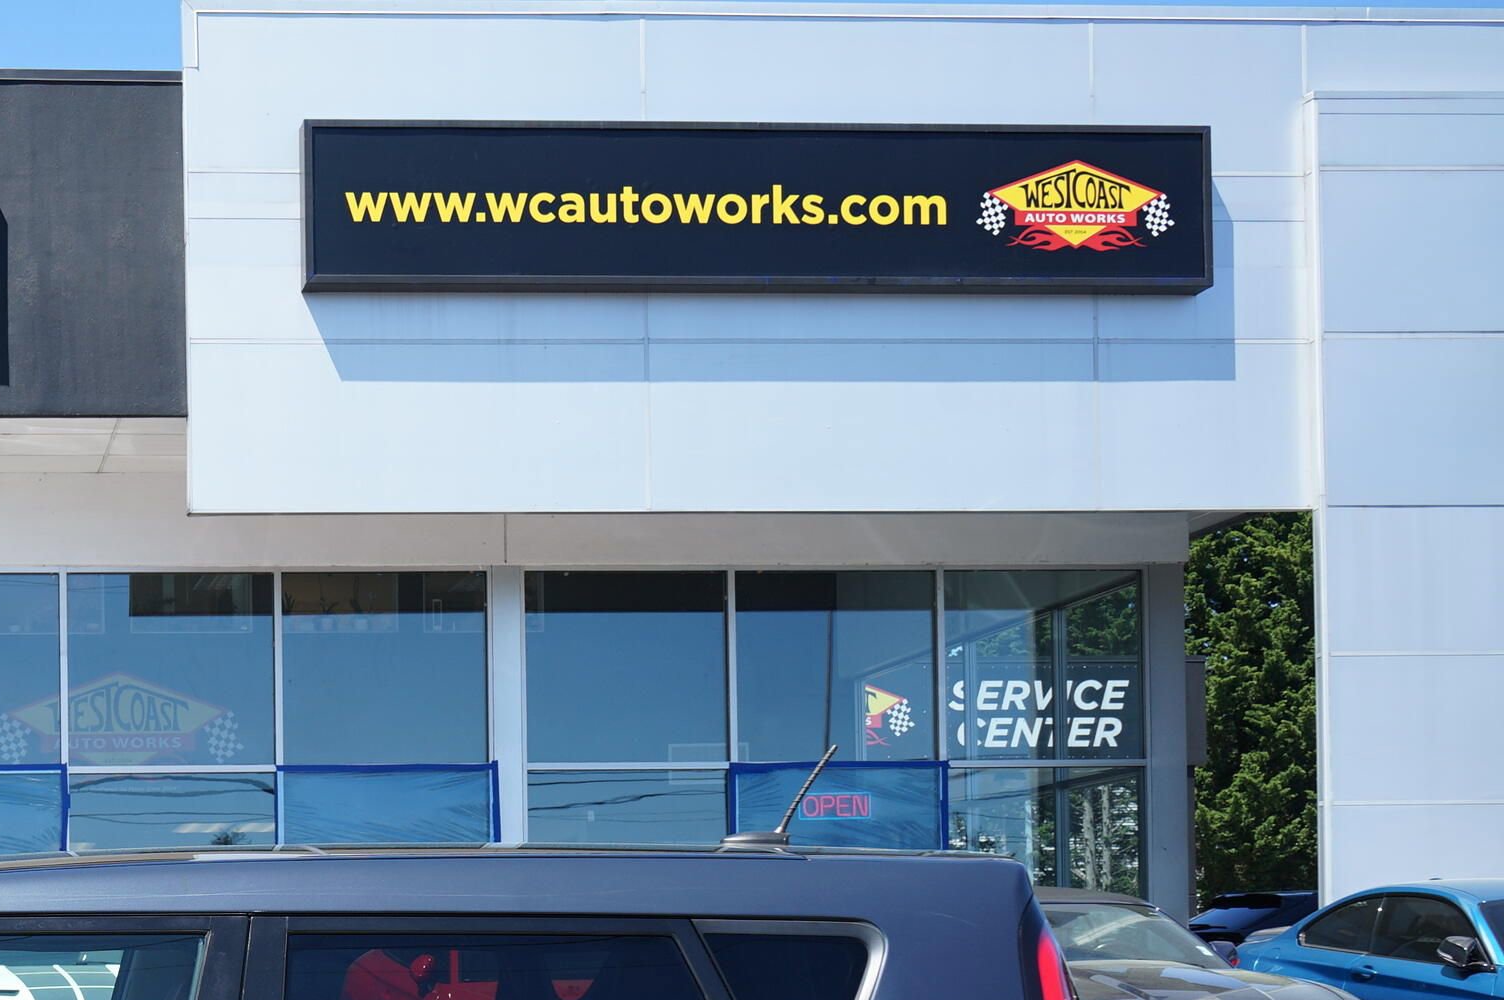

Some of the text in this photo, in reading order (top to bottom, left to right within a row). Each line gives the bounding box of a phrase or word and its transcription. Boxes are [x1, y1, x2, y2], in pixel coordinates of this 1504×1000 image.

[345, 184, 948, 226] www.wcautoworks.com
[1024, 213, 1126, 224] AUTO WORKS
[112, 736, 183, 749] WORKS
[802, 795, 869, 817] OPEN
